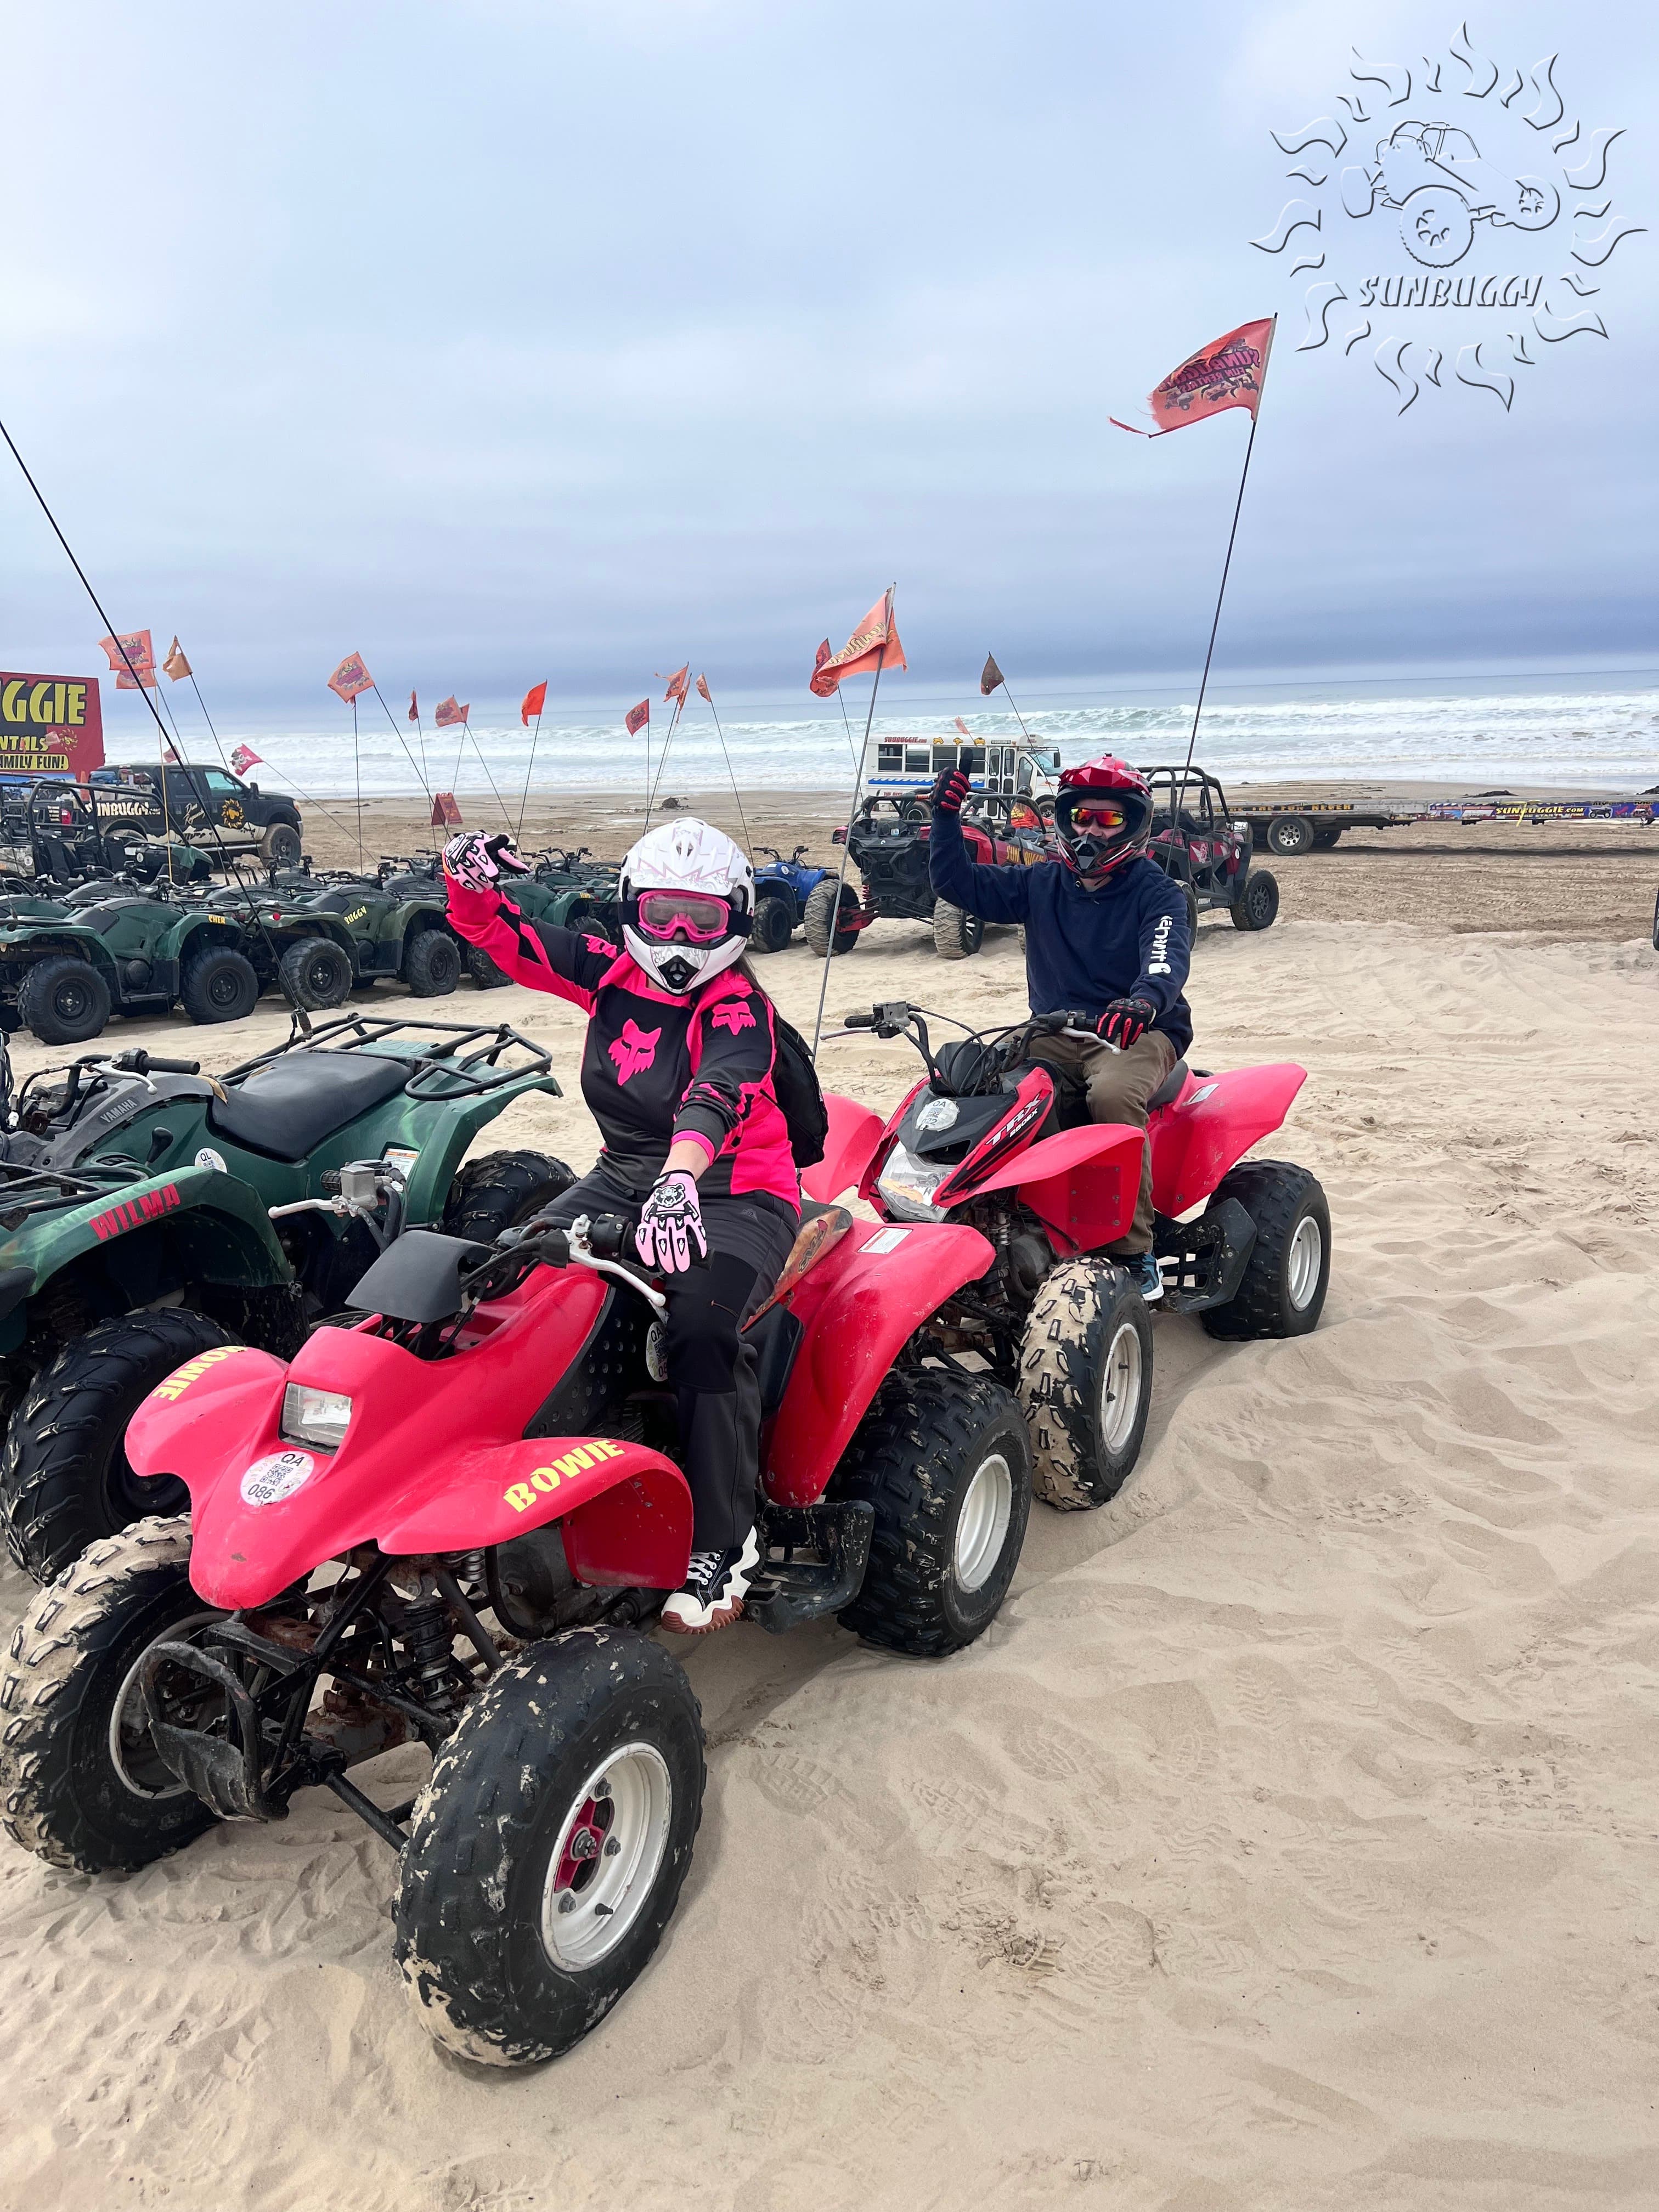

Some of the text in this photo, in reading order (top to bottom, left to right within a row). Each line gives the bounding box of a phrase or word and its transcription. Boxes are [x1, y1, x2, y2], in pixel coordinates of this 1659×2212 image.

[0, 680, 86, 725] GGIE
[37, 755, 65, 769] FUN!
[100, 1099, 137, 1122] YAMAHA
[985, 1093, 1040, 1146] TRX
[200, 1152, 212, 1161] QL
[89, 1182, 180, 1241] WILMA
[281, 1453, 305, 1466] QA
[503, 1439, 626, 1513] BOWIE
[247, 1483, 275, 1499] 086
